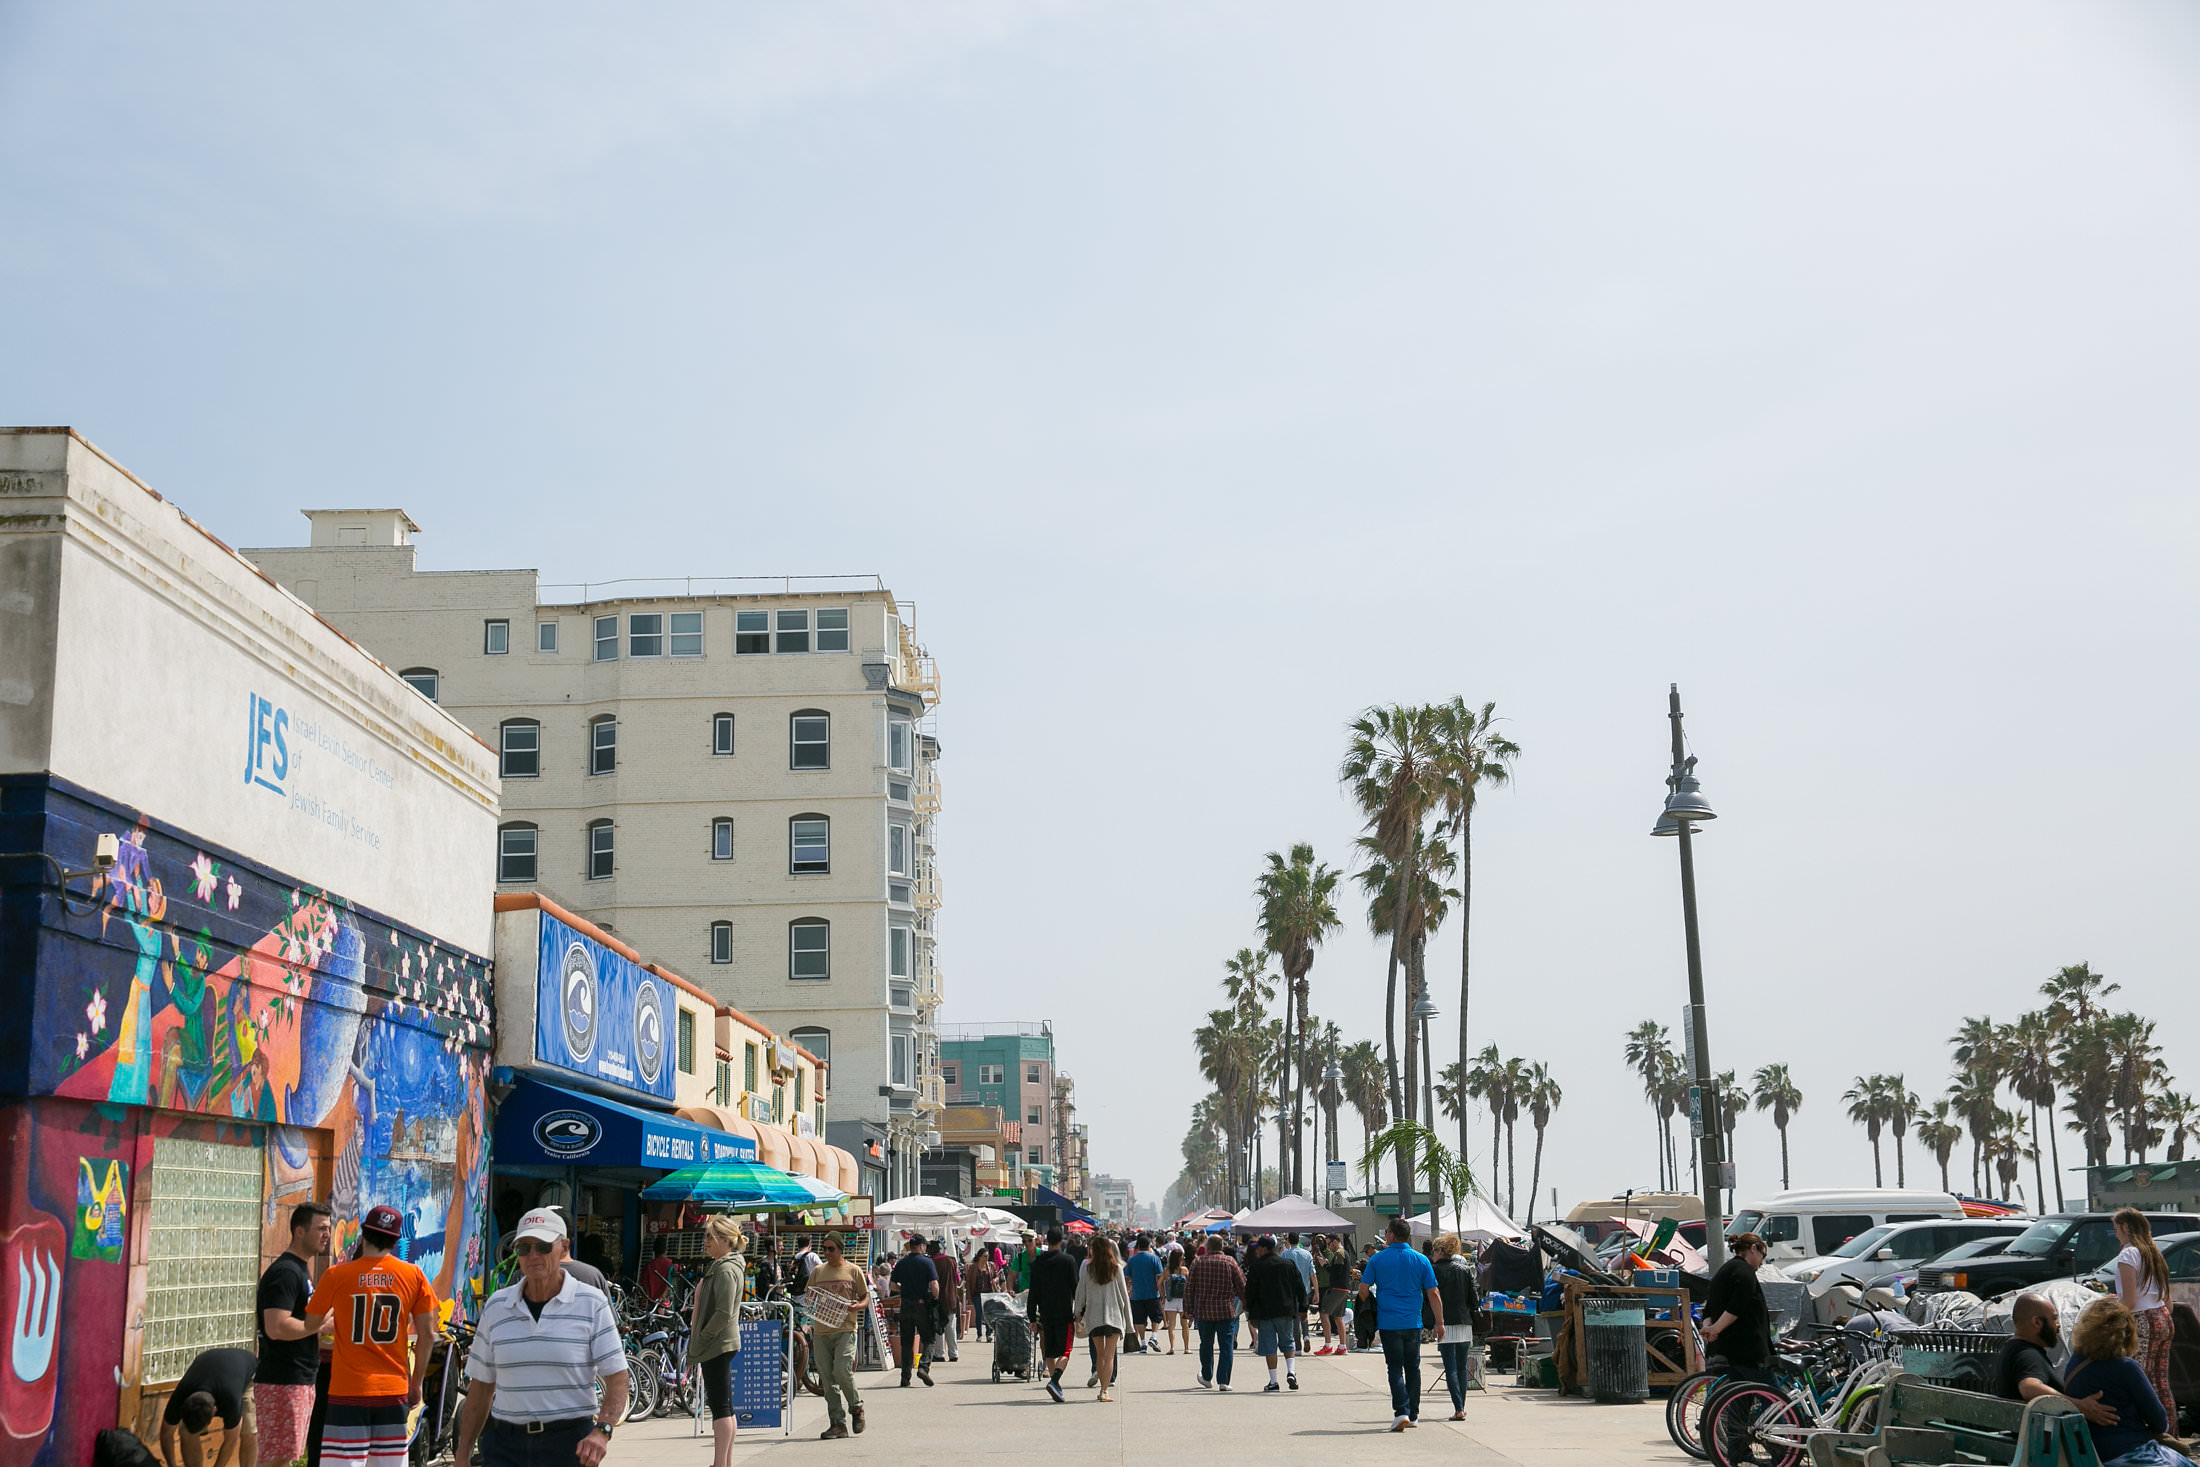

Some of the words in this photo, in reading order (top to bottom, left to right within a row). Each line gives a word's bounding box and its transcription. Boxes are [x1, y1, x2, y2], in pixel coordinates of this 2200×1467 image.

[244, 691, 289, 784] JFS
[293, 711, 317, 744] Israel
[318, 725, 340, 759] Levin
[342, 740, 368, 773] Senior
[369, 757, 395, 790] Center
[291, 749, 302, 770] of
[289, 784, 321, 820] Jewish
[322, 800, 348, 840] Family
[351, 815, 380, 849] Service
[562, 1149, 591, 1160] California
[646, 1133, 670, 1158] BICYCLE
[671, 1137, 695, 1160] RENTALS
[714, 1142, 739, 1160] BOARDK
[359, 1273, 396, 1288] PERRY
[350, 1293, 402, 1345] 10
[740, 1322, 759, 1331] ATES
